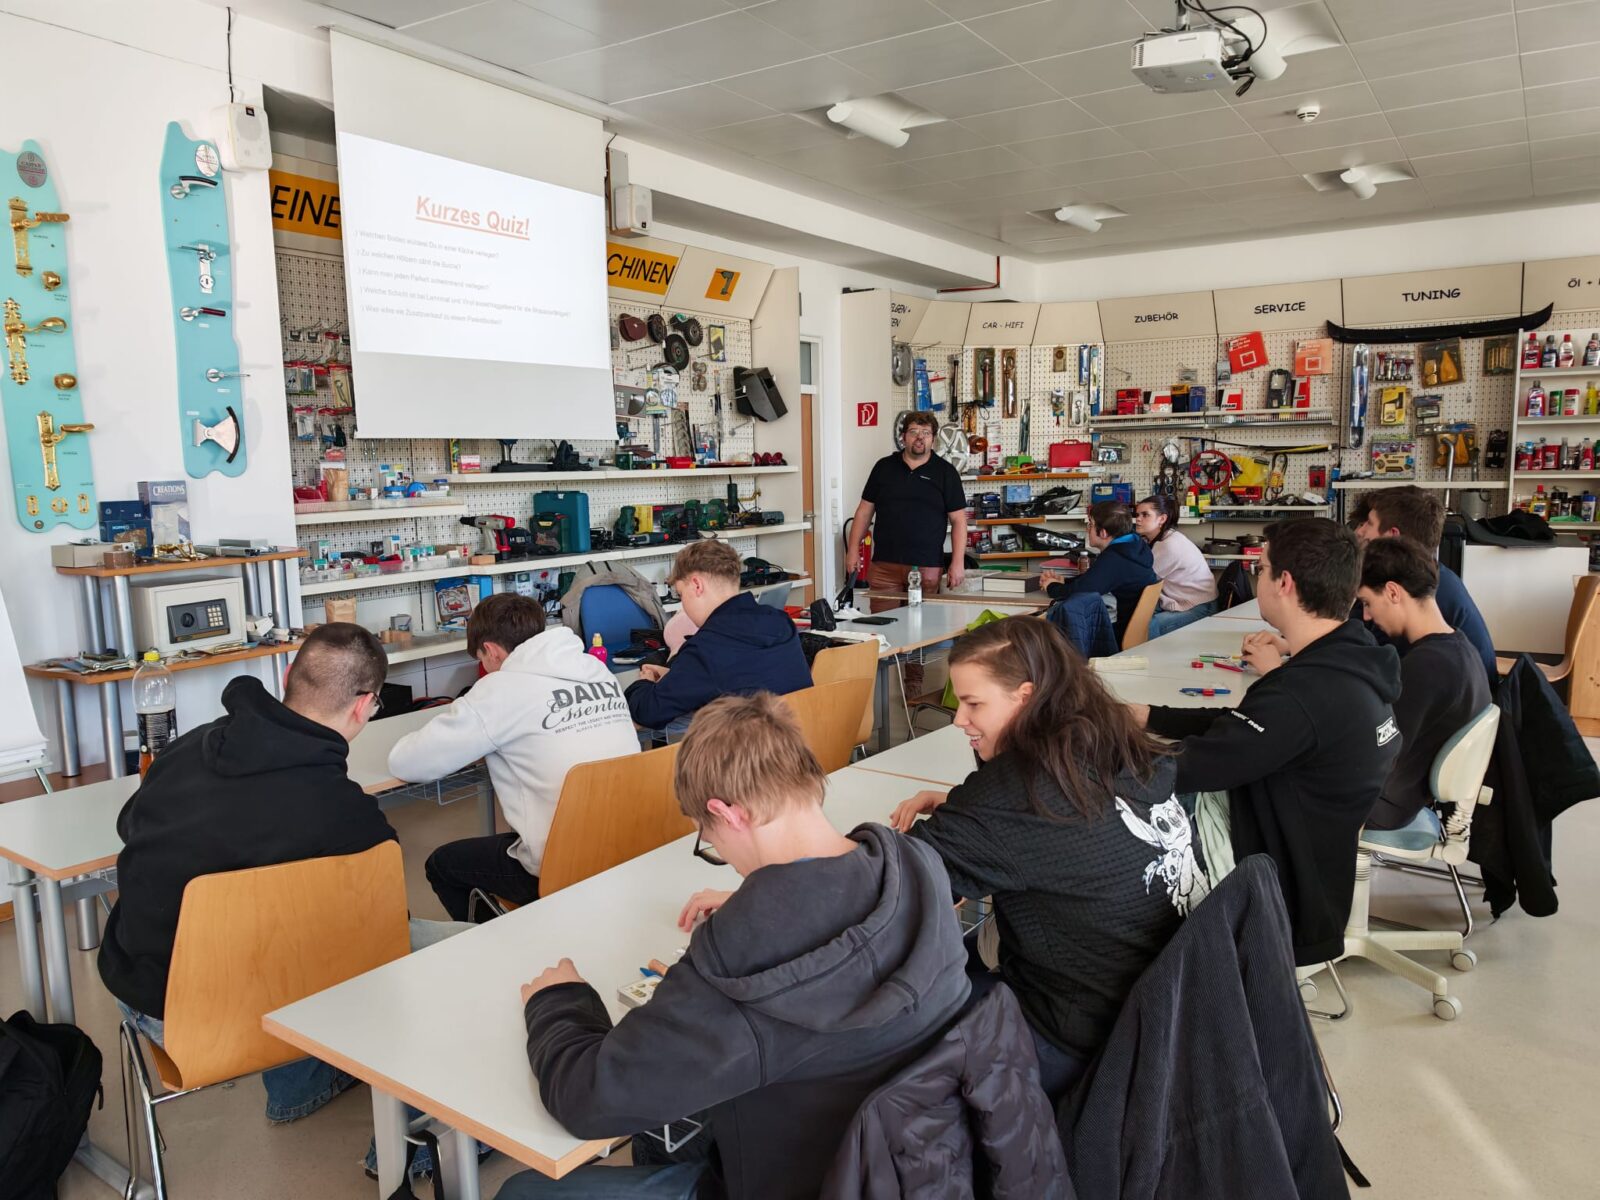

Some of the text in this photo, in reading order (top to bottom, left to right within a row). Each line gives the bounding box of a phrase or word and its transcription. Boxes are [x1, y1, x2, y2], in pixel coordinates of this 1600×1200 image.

[416, 195, 530, 236] Kurzes Quiz!
[1401, 288, 1461, 302] TUNING
[1254, 301, 1307, 314] SERVICE
[1134, 311, 1179, 324] ZUBEHÖR
[982, 321, 998, 329] CAR
[1004, 321, 1024, 329] HIFI
[552, 681, 621, 709] DAILY
